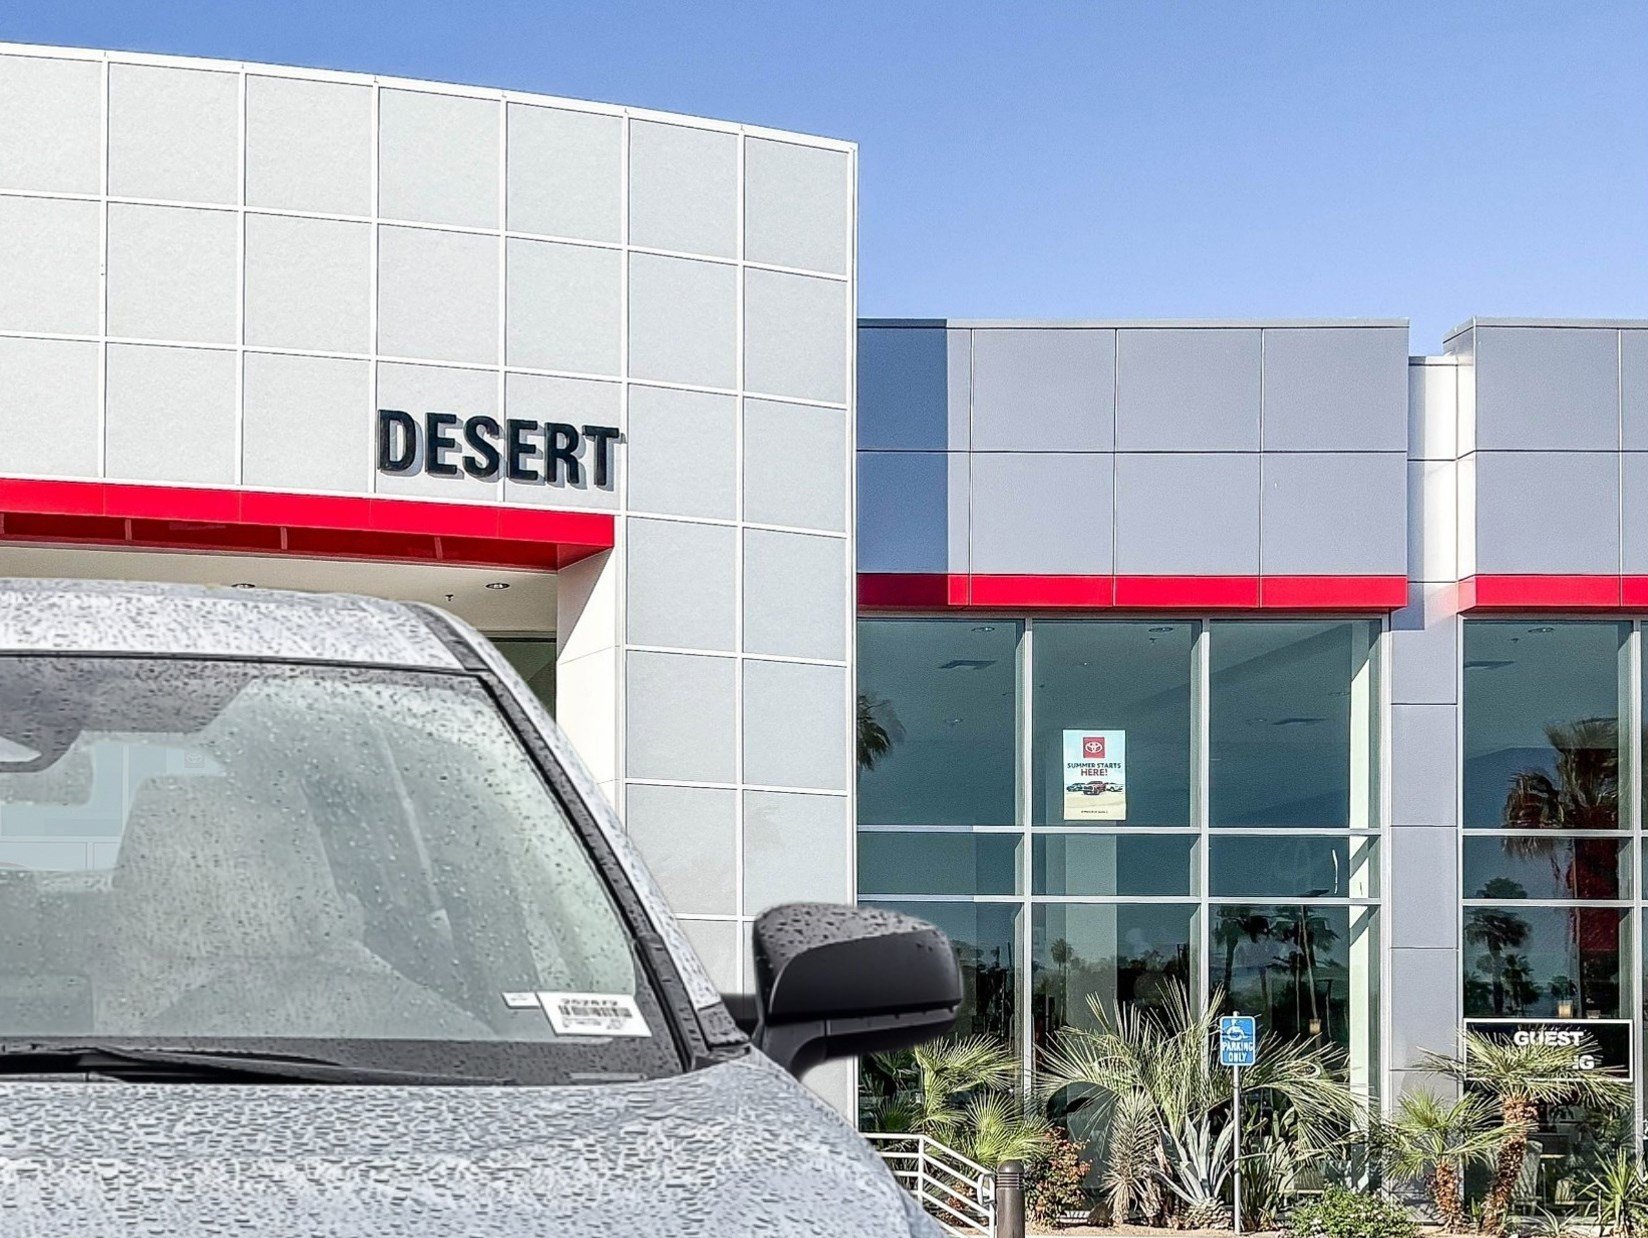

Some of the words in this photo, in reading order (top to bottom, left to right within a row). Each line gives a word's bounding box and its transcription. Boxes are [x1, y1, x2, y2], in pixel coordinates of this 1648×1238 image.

[376, 408, 620, 487] DESERT
[1513, 1031, 1584, 1047] GUEST
[1223, 1041, 1253, 1052] PARKING
[1228, 1052, 1247, 1062] ONLY
